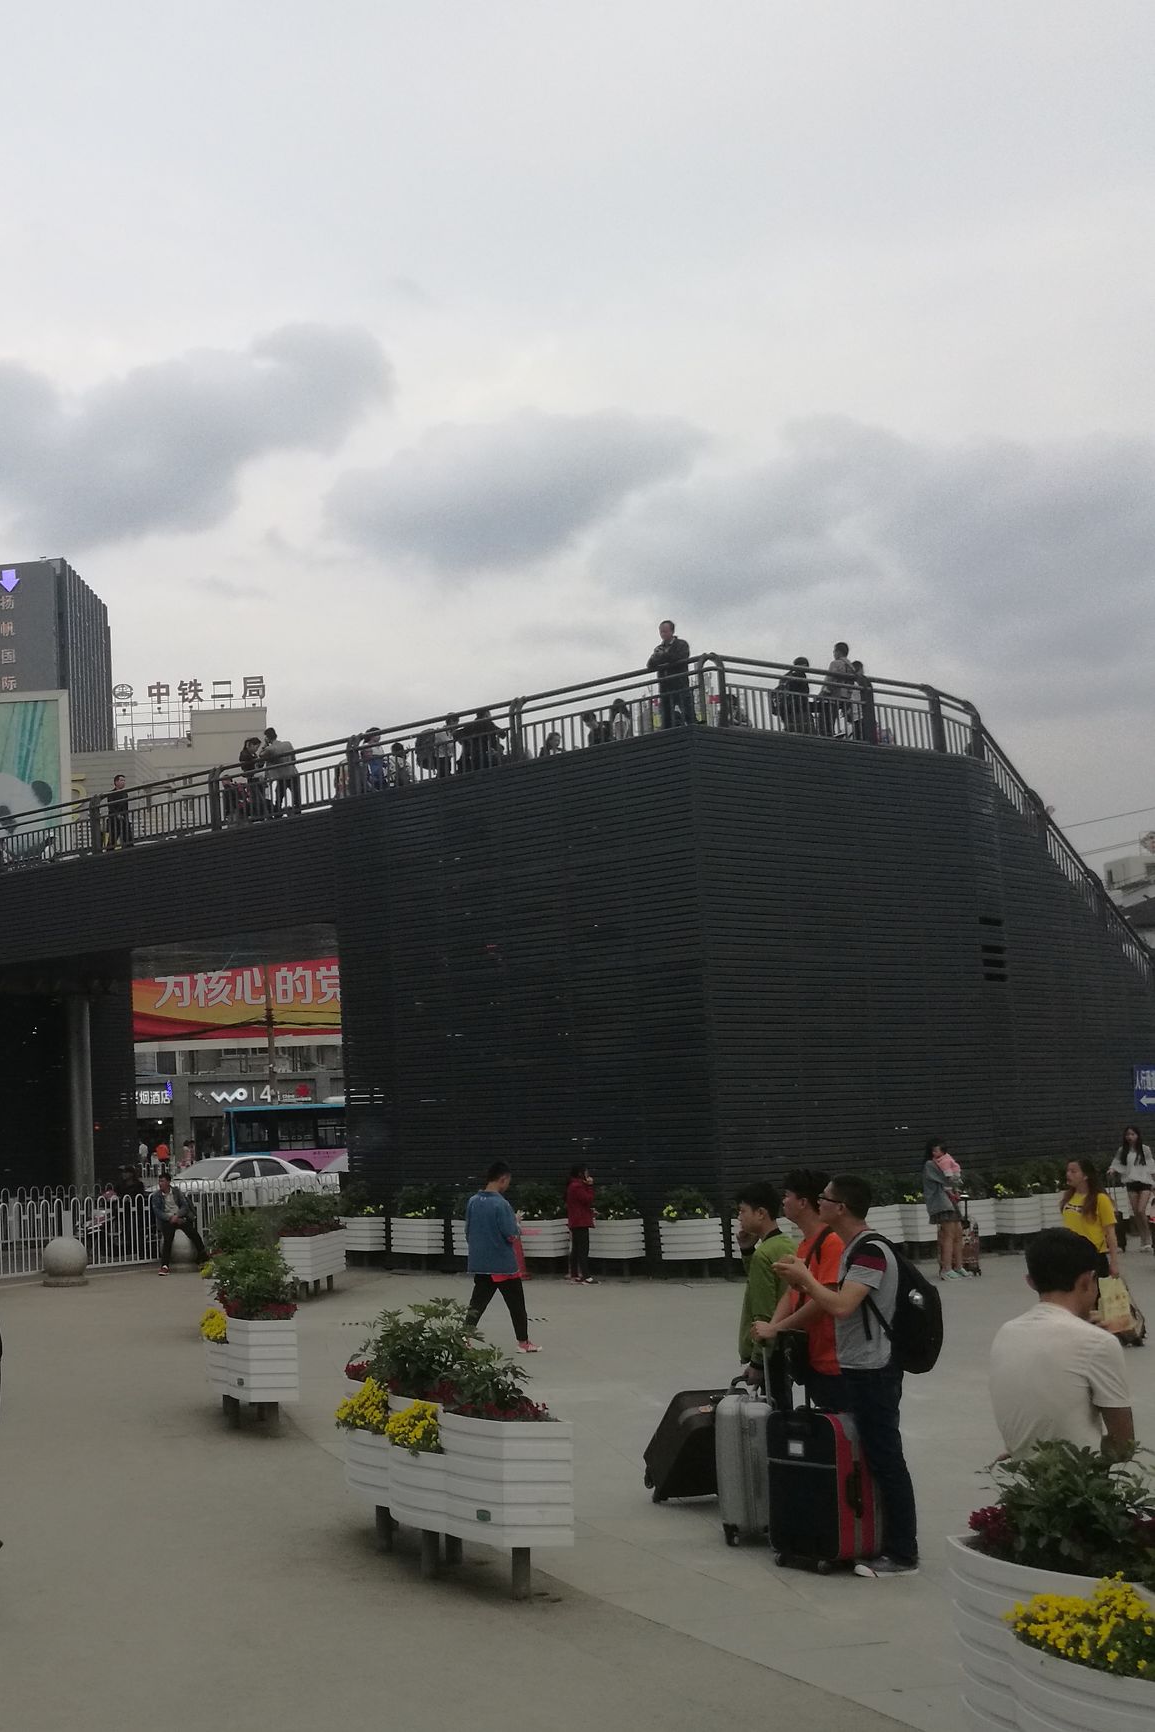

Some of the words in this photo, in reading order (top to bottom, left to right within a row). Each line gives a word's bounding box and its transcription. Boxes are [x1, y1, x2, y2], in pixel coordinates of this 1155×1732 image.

[0, 595, 18, 691] 扬帆国际
[147, 675, 266, 705] 中铁二局
[135, 1090, 171, 1105] 烟酒店
